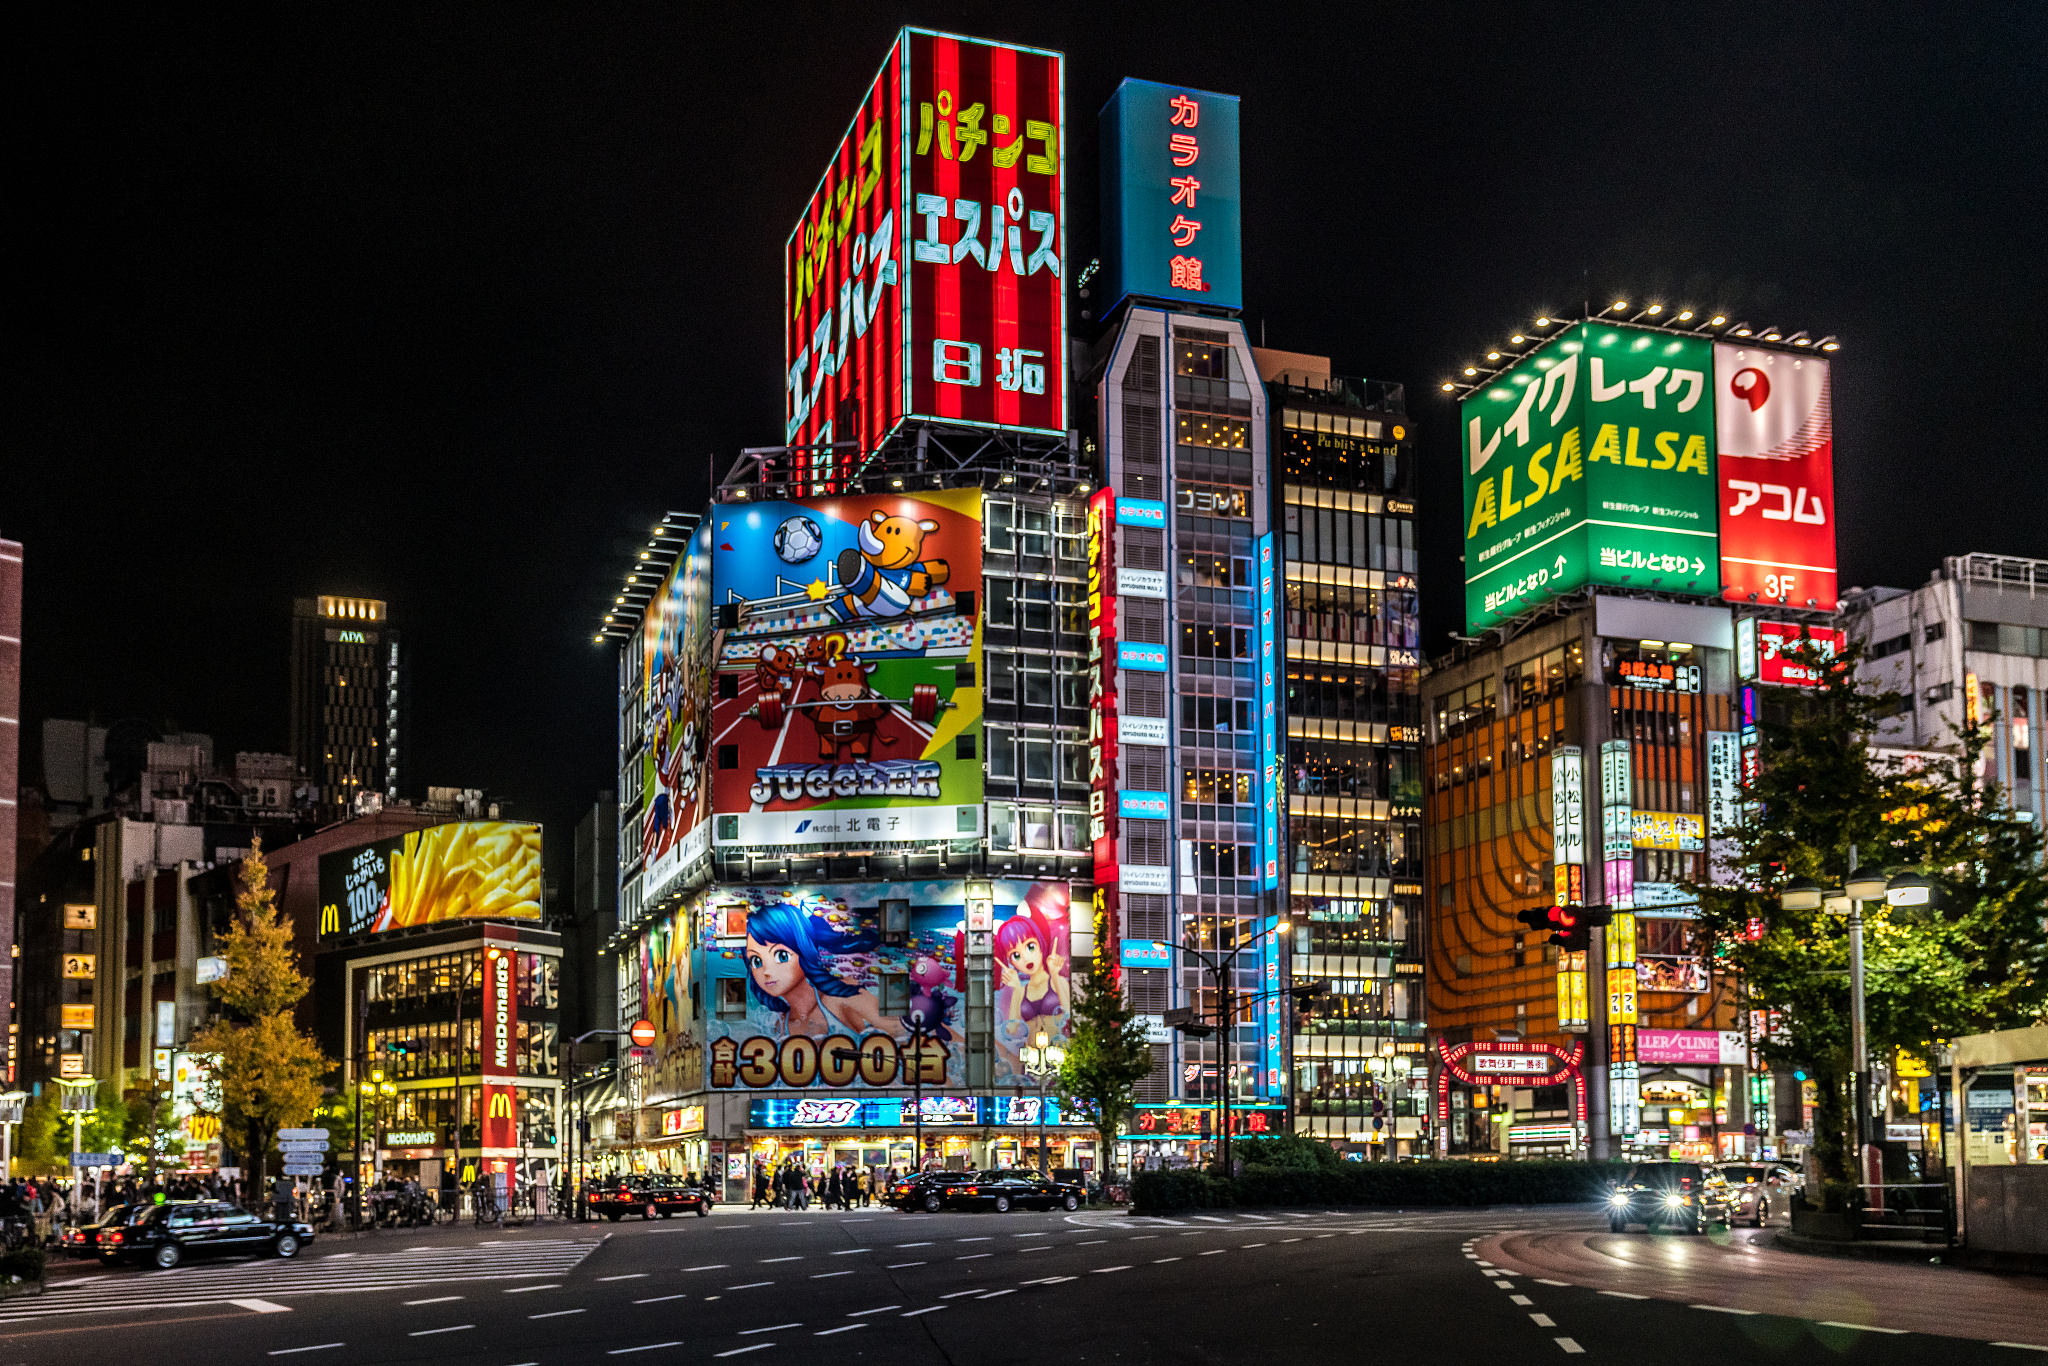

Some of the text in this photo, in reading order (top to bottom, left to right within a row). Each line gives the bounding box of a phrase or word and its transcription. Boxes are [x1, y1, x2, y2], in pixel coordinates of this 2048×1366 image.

[916, 89, 1058, 176] パチンコ
[1169, 94, 1202, 291] カラオケ館
[794, 116, 882, 321] パチンコ
[914, 186, 1060, 278] エスパス
[786, 208, 899, 448] エスパス
[1589, 356, 1705, 413] レイク
[1468, 353, 1578, 476] レイク
[1588, 422, 1709, 476] ALSA
[1467, 425, 1583, 540] ALSA
[1728, 478, 1826, 526] アコム
[1119, 505, 1164, 520] カラオケ館
[1088, 504, 1101, 621] パチンコ
[1600, 546, 1690, 574] 当ビルとなり
[1484, 568, 1549, 613] 当ビルとなり
[1765, 574, 1796, 598] 3F
[339, 630, 365, 644] APA
[1121, 649, 1165, 663] カラオケ館
[1089, 625, 1102, 784] エスパス
[750, 756, 942, 804] JUGGLER
[1122, 798, 1167, 811] カラオケ館
[812, 815, 901, 833] 株式会社 北電子
[1553, 768, 1565, 849] 小松ビル
[1567, 767, 1581, 848] 小松ビル
[345, 856, 385, 892] じゃがいも
[352, 848, 376, 871] まるごと
[347, 879, 388, 924] 100%
[1124, 948, 1169, 960] カラオケ館
[495, 956, 509, 1068] McDonald's
[1265, 929, 1278, 1089] カラオケ館
[740, 1033, 951, 1088] 3000台
[1478, 1058, 1545, 1070] 歌舞伎町一番街
[387, 1131, 436, 1147] McDonald's
